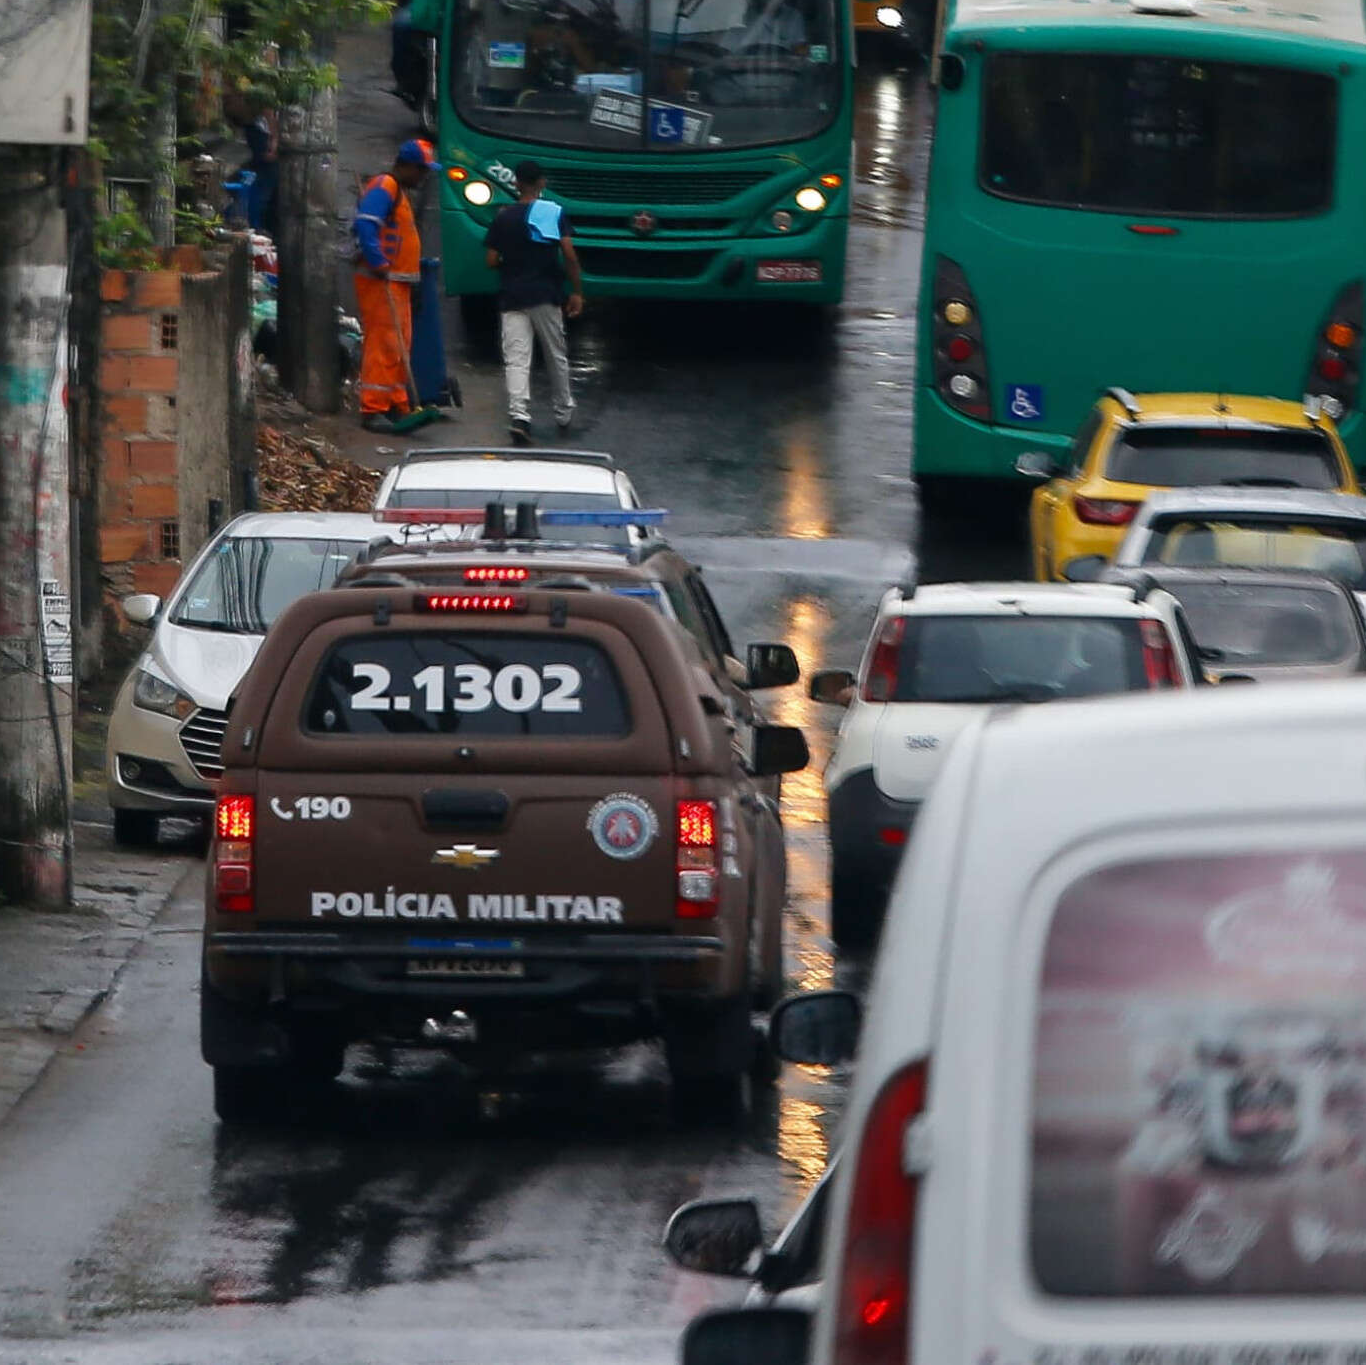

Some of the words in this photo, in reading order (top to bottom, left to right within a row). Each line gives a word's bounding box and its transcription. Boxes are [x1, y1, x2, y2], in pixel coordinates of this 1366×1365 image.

[349, 663, 584, 714] 2.1302
[293, 796, 352, 821] 190
[310, 885, 458, 920] POLÍCIA
[467, 893, 624, 924] MILITAR
